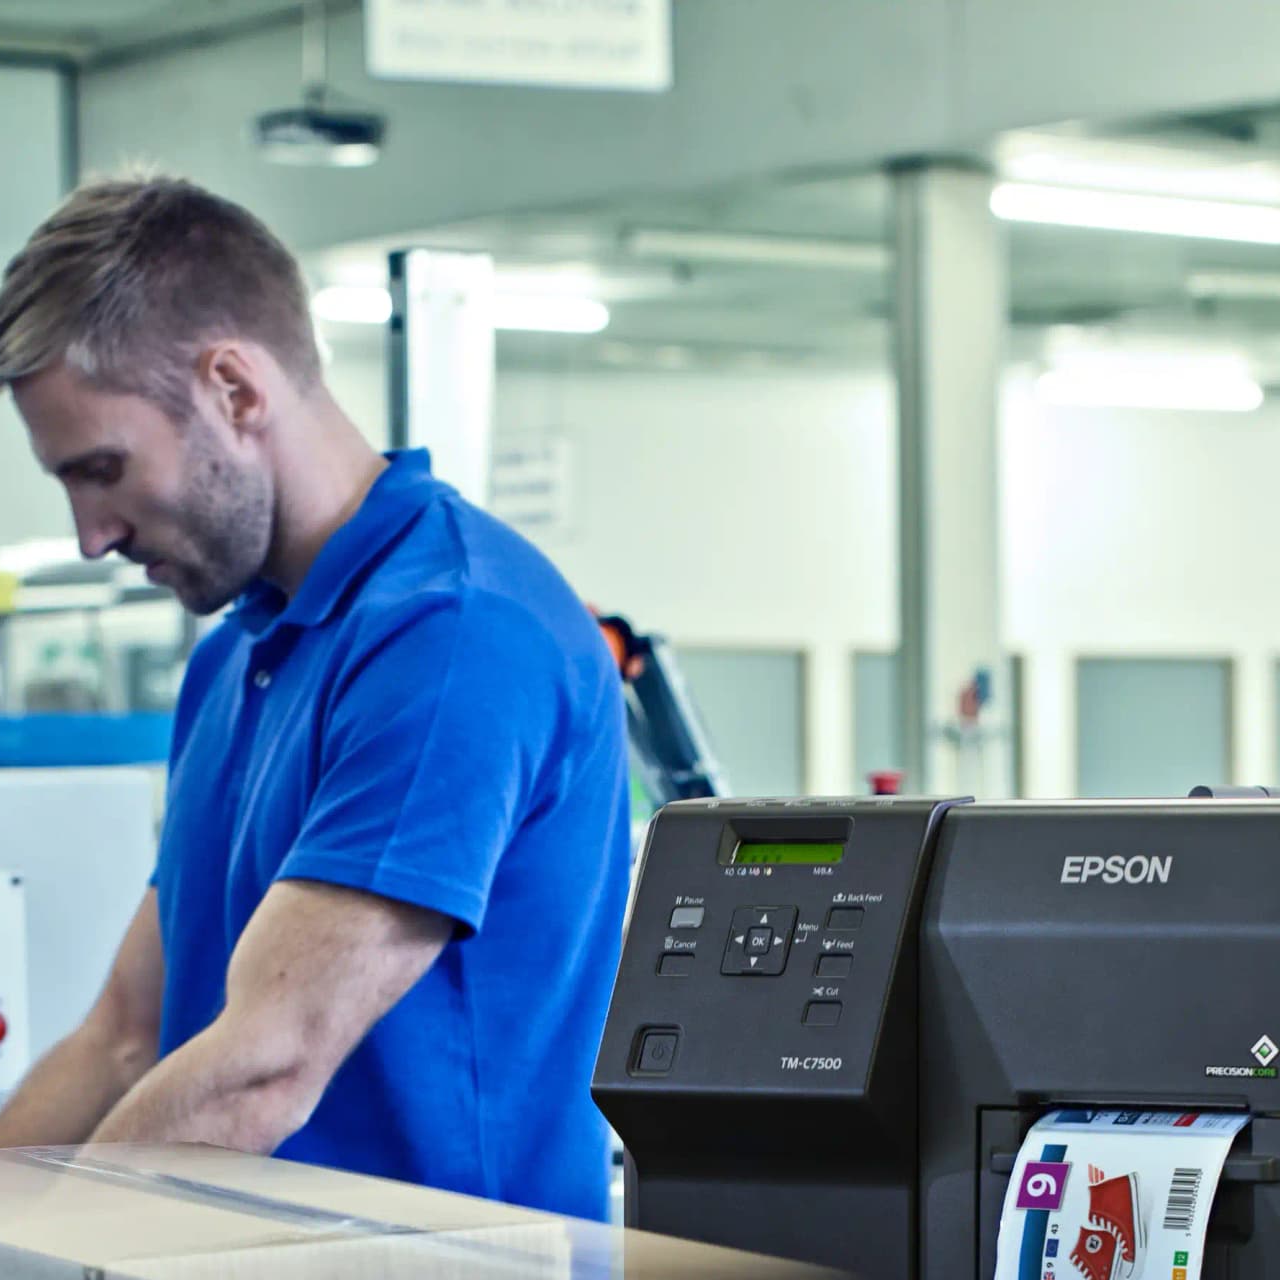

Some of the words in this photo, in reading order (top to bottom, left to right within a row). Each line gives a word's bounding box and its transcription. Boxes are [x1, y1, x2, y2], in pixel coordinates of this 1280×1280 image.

[1060, 855, 1173, 885] EPSON
[684, 896, 705, 905] Pause
[847, 893, 865, 902] Back
[865, 893, 883, 902] Feed
[797, 922, 819, 932] Menu
[673, 940, 697, 949] Cancel
[751, 937, 766, 946] OK
[836, 940, 855, 949] Feed
[825, 987, 839, 996] Cut
[780, 1056, 842, 1070] TM-C7500
[1206, 1066, 1277, 1077] PRECISIONCORE
[1027, 1172, 1057, 1197] 9
